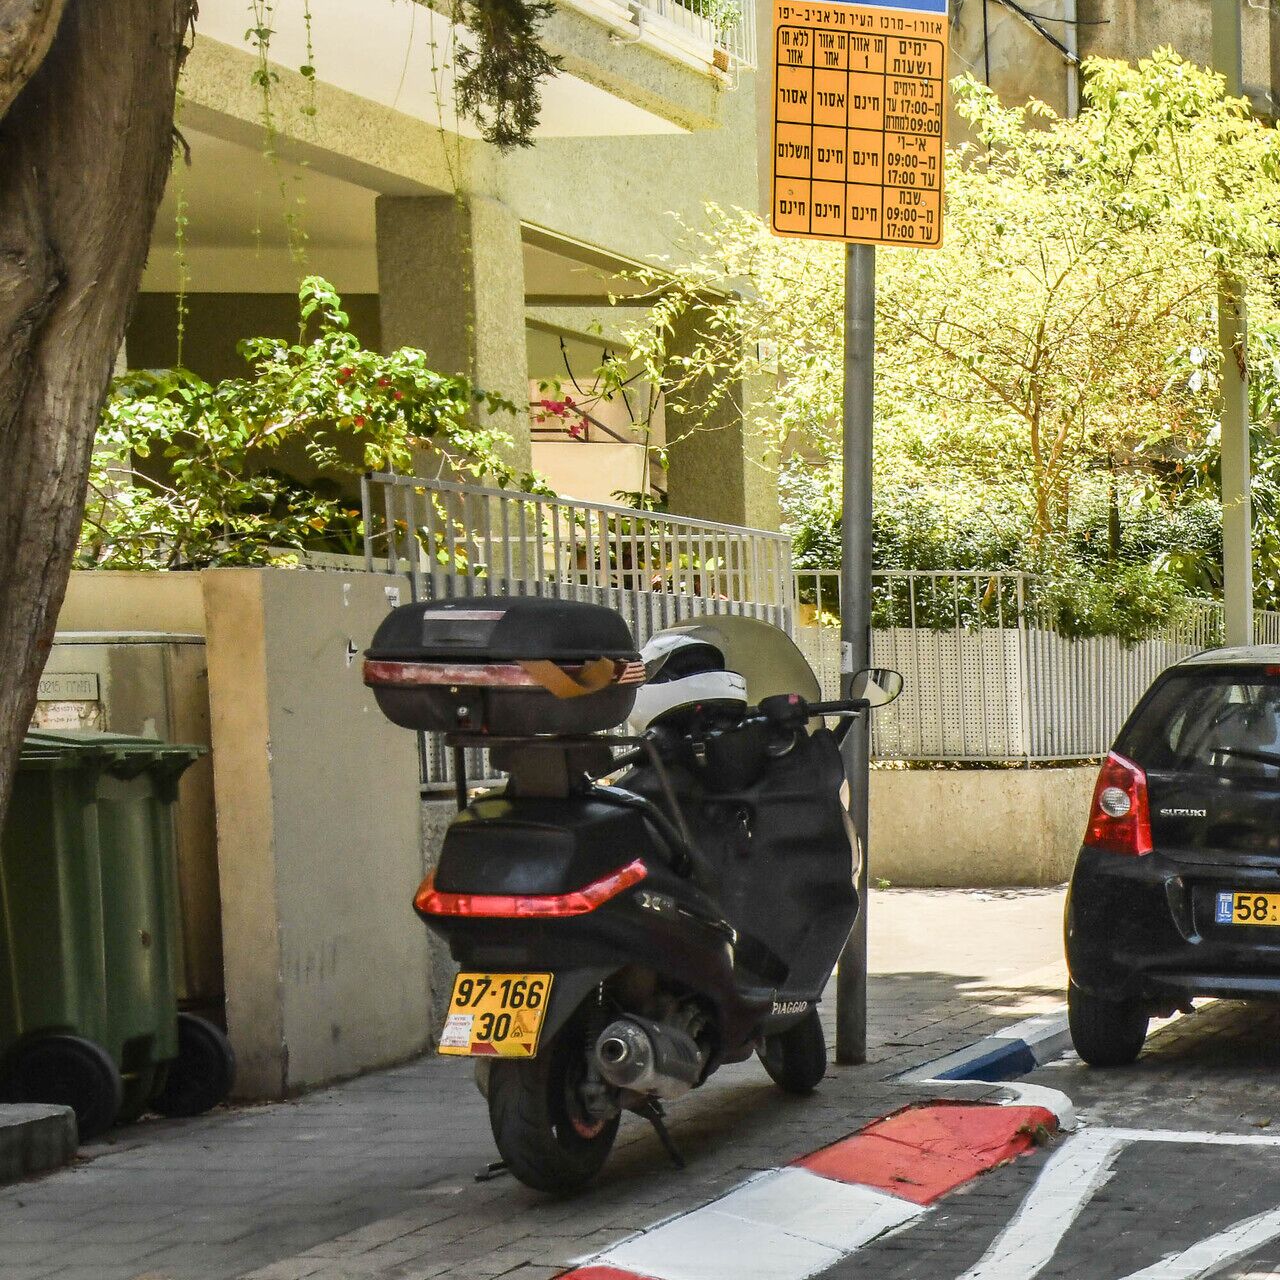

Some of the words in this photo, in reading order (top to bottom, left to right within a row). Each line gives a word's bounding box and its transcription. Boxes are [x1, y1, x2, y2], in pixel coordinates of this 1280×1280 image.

[833, 10, 846, 24] תל
[850, 13, 873, 27] העיר
[781, 31, 790, 45] תו
[793, 30, 809, 47] ללא
[818, 33, 834, 49] אזור
[838, 35, 846, 50] תו
[852, 36, 870, 52] אזור
[874, 38, 883, 53] תו
[786, 49, 803, 64] אזור
[899, 40, 927, 57] ימים
[824, 50, 839, 66] אחר
[893, 58, 932, 76] ושעות
[779, 88, 808, 105] אסור
[893, 81, 916, 97] הימים
[920, 81, 934, 99] בכל
[817, 91, 845, 108] אסור
[853, 95, 880, 111] חינם
[886, 97, 897, 112] עד
[778, 141, 810, 160] תשלום
[817, 148, 843, 164] חינם
[853, 151, 879, 167] חינם
[888, 170, 915, 184] 17:00
[921, 172, 935, 187] עד
[899, 191, 922, 206] שבת
[779, 200, 805, 216] חינם
[815, 203, 840, 219] חינם
[852, 206, 877, 222] חינם
[887, 223, 914, 238] 17:00
[919, 226, 933, 240] עד
[771, 1000, 808, 1016] PIAGGIO
[476, 1012, 512, 1042] 30
